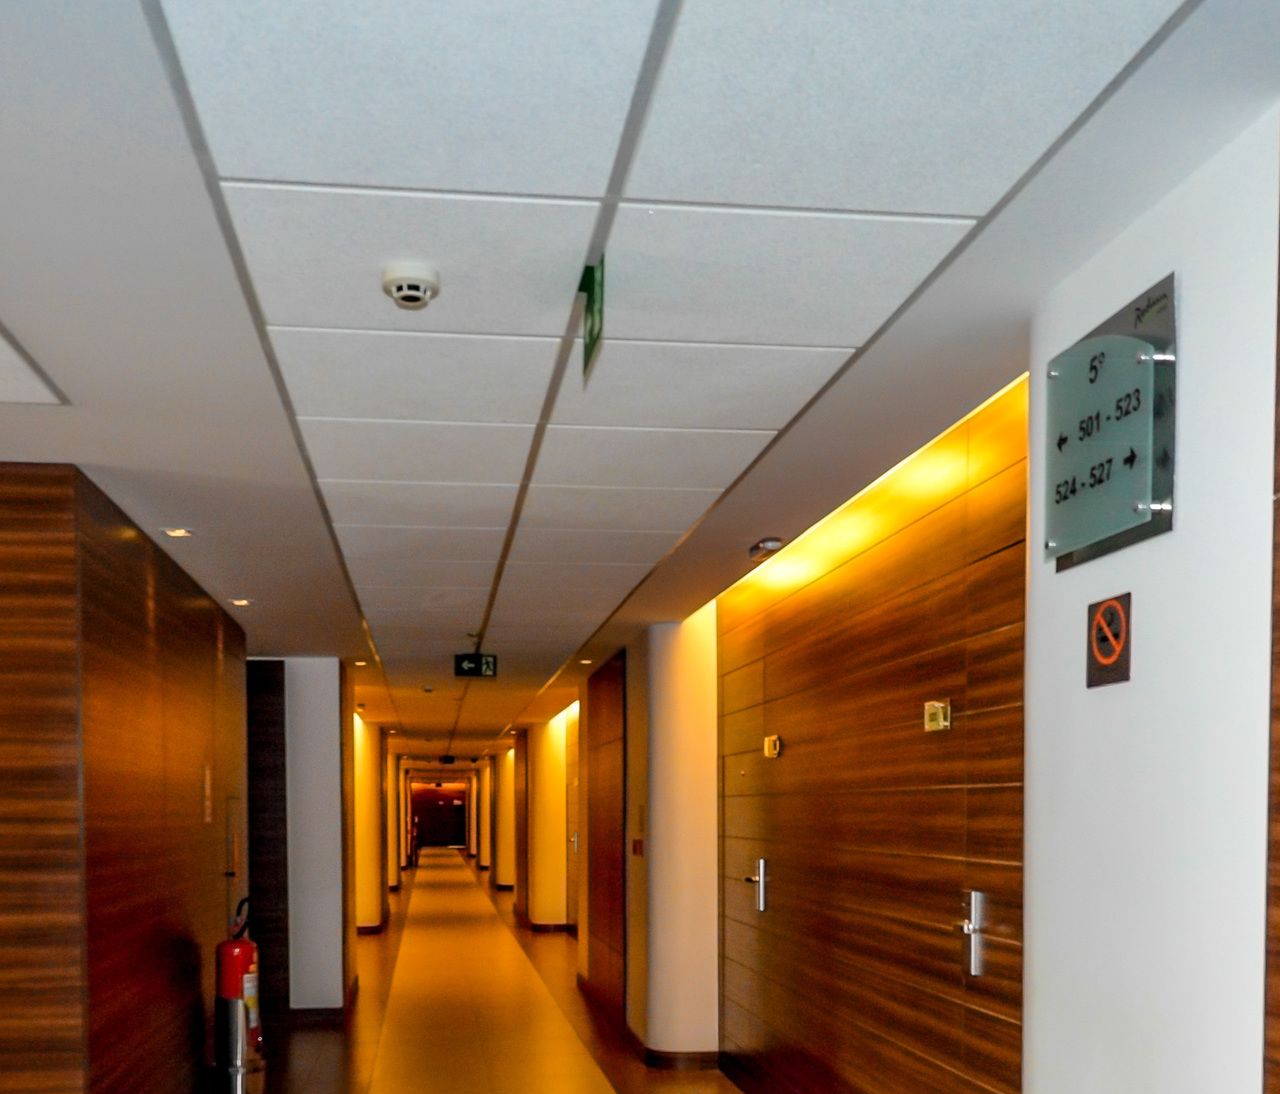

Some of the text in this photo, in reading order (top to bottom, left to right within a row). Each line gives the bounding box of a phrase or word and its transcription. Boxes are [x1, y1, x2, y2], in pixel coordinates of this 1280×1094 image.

[1078, 410, 1100, 441] 501
[1115, 388, 1141, 421] 523
[1055, 475, 1077, 504] 524
[1089, 457, 1113, 488] 527
